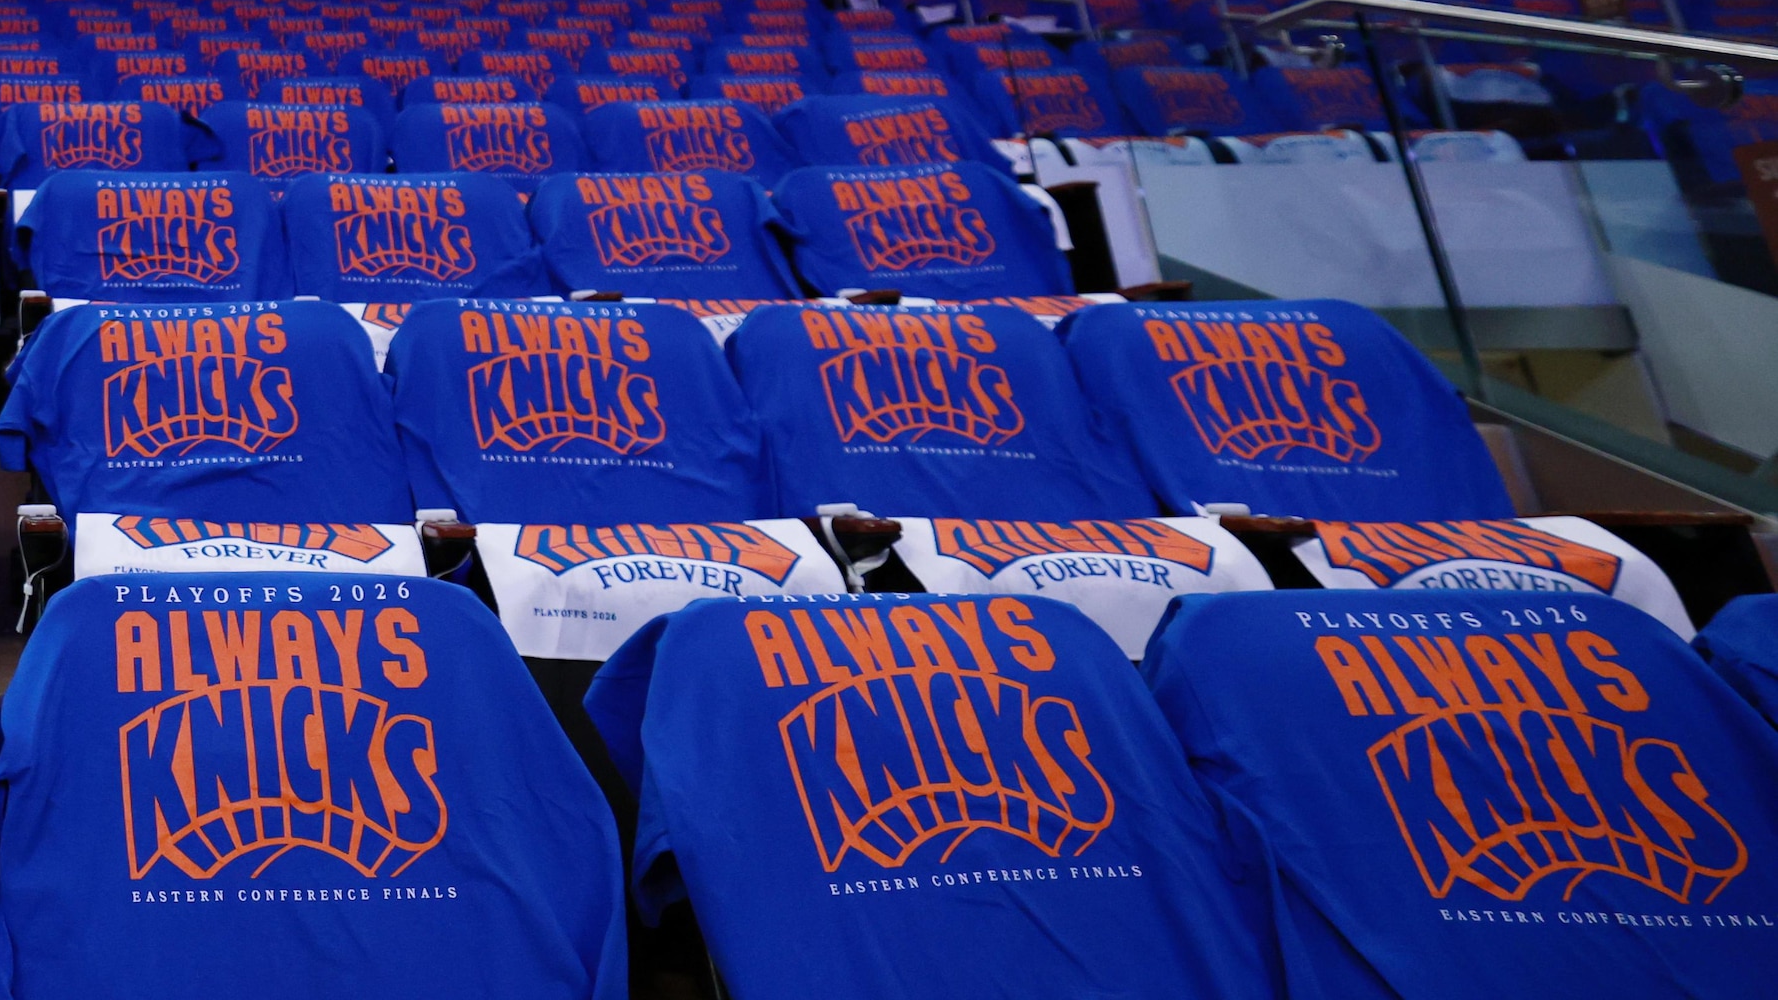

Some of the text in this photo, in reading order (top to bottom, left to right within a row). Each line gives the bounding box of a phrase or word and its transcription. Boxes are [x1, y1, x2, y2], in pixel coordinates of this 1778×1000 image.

[0, 83, 82, 103] ALWAYS
[142, 83, 223, 106] ALWAYS
[282, 87, 362, 106] ALWAYS
[435, 80, 516, 100] ALWAYS
[579, 84, 657, 104] ALWAYS
[724, 82, 803, 104] ALWAYS
[861, 76, 947, 96] ALWAYS
[40, 103, 141, 124] ALWAYS
[247, 108, 349, 132] ALWAYS
[442, 106, 545, 126] ALWAYS
[639, 105, 742, 127] ALWAYS
[847, 109, 948, 146] ALWAYS
[41, 117, 142, 169] KNICKS
[249, 127, 353, 175] KNICKS
[446, 121, 552, 173] KNICKS
[97, 187, 233, 219] ALWAYS
[330, 183, 466, 217] ALWAYS
[577, 174, 713, 205] ALWAYS
[831, 171, 971, 211] ALWAYS
[98, 213, 240, 283] KNICKS
[334, 208, 475, 280] KNICKS
[588, 199, 730, 267] KNICKS
[845, 201, 995, 271] KNICKS
[99, 302, 278, 319] PLAYOFFS 2026
[458, 298, 637, 317] PLAYOFFS 2026
[99, 312, 286, 362] ALWAYS
[460, 311, 650, 362] ALWAYS
[800, 310, 996, 353] ALWAYS
[1144, 320, 1345, 366] ALWAYS
[104, 351, 299, 458] KNICKS
[468, 350, 666, 455] KNICKS
[820, 346, 1024, 445] KNICKS
[1169, 357, 1381, 463] KNICKS
[182, 546, 328, 568] FOREVER
[1022, 557, 1174, 590] FOREVER
[116, 581, 411, 604] PLAYOFFS 2026
[593, 560, 743, 597] FOREVER
[534, 608, 617, 621] PLAYOFFS 2026
[1296, 605, 1589, 630] PLAYOFFS 2026
[114, 607, 428, 693] ALWAYS
[744, 597, 1056, 688] ALWAYS
[1314, 630, 1650, 717] ALWAYS
[119, 683, 448, 880] KNICKS
[778, 669, 1115, 873] KNICKS
[1366, 708, 1749, 905] KNICKS
[131, 885, 458, 903] EASTERN CONFERENCE FINALS
[830, 864, 1144, 896] EASTERN CONFERENCE FINALS
[1440, 908, 1778, 928] EASTERN CONFERENCE FINAL
